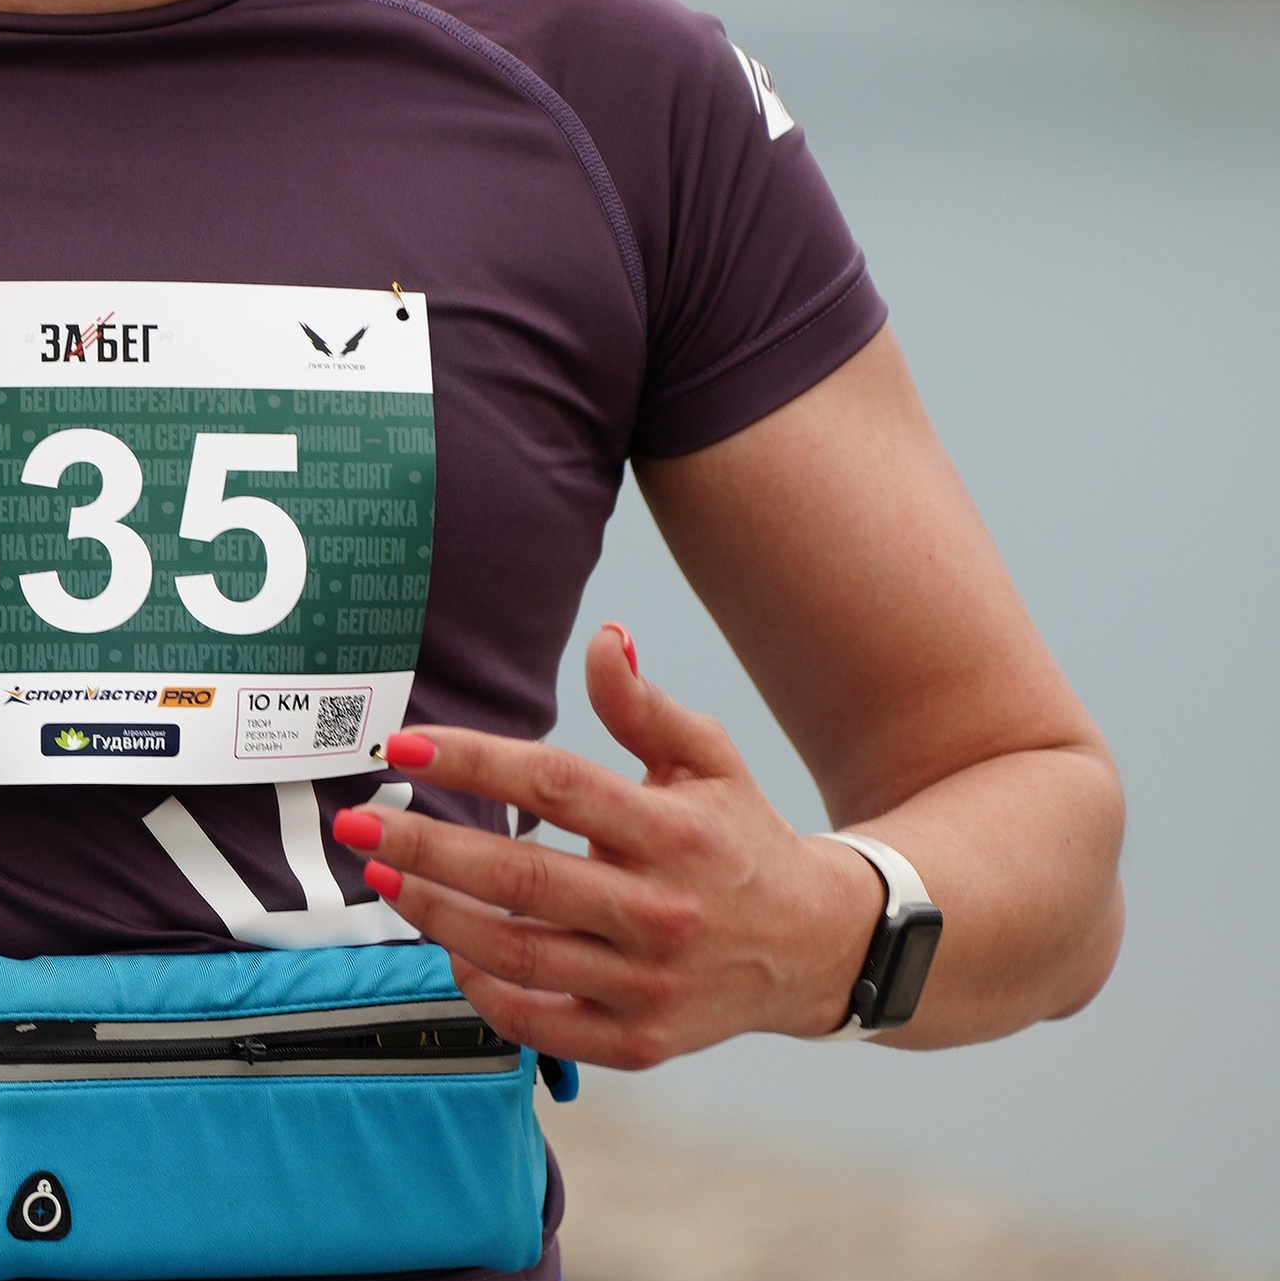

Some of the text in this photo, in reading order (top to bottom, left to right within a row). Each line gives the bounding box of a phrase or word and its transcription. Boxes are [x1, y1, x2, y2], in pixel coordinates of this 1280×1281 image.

[302, 461, 340, 489] ВСЕ
[342, 462, 393, 490] СПЯТ
[1, 533, 28, 562] НА
[319, 535, 406, 568] СЕРДЦЕМ
[350, 573, 398, 602] ПОКА
[400, 573, 429, 602] ВС
[337, 606, 416, 635] БЕГОВАЯ
[21, 641, 100, 671] НАЧАЛО
[133, 641, 305, 673] НА СТАРТЕ ЖИЗНИ
[163, 691, 213, 705] PRO
[248, 694, 271, 710] 10
[92, 734, 166, 752] Гудвилл
